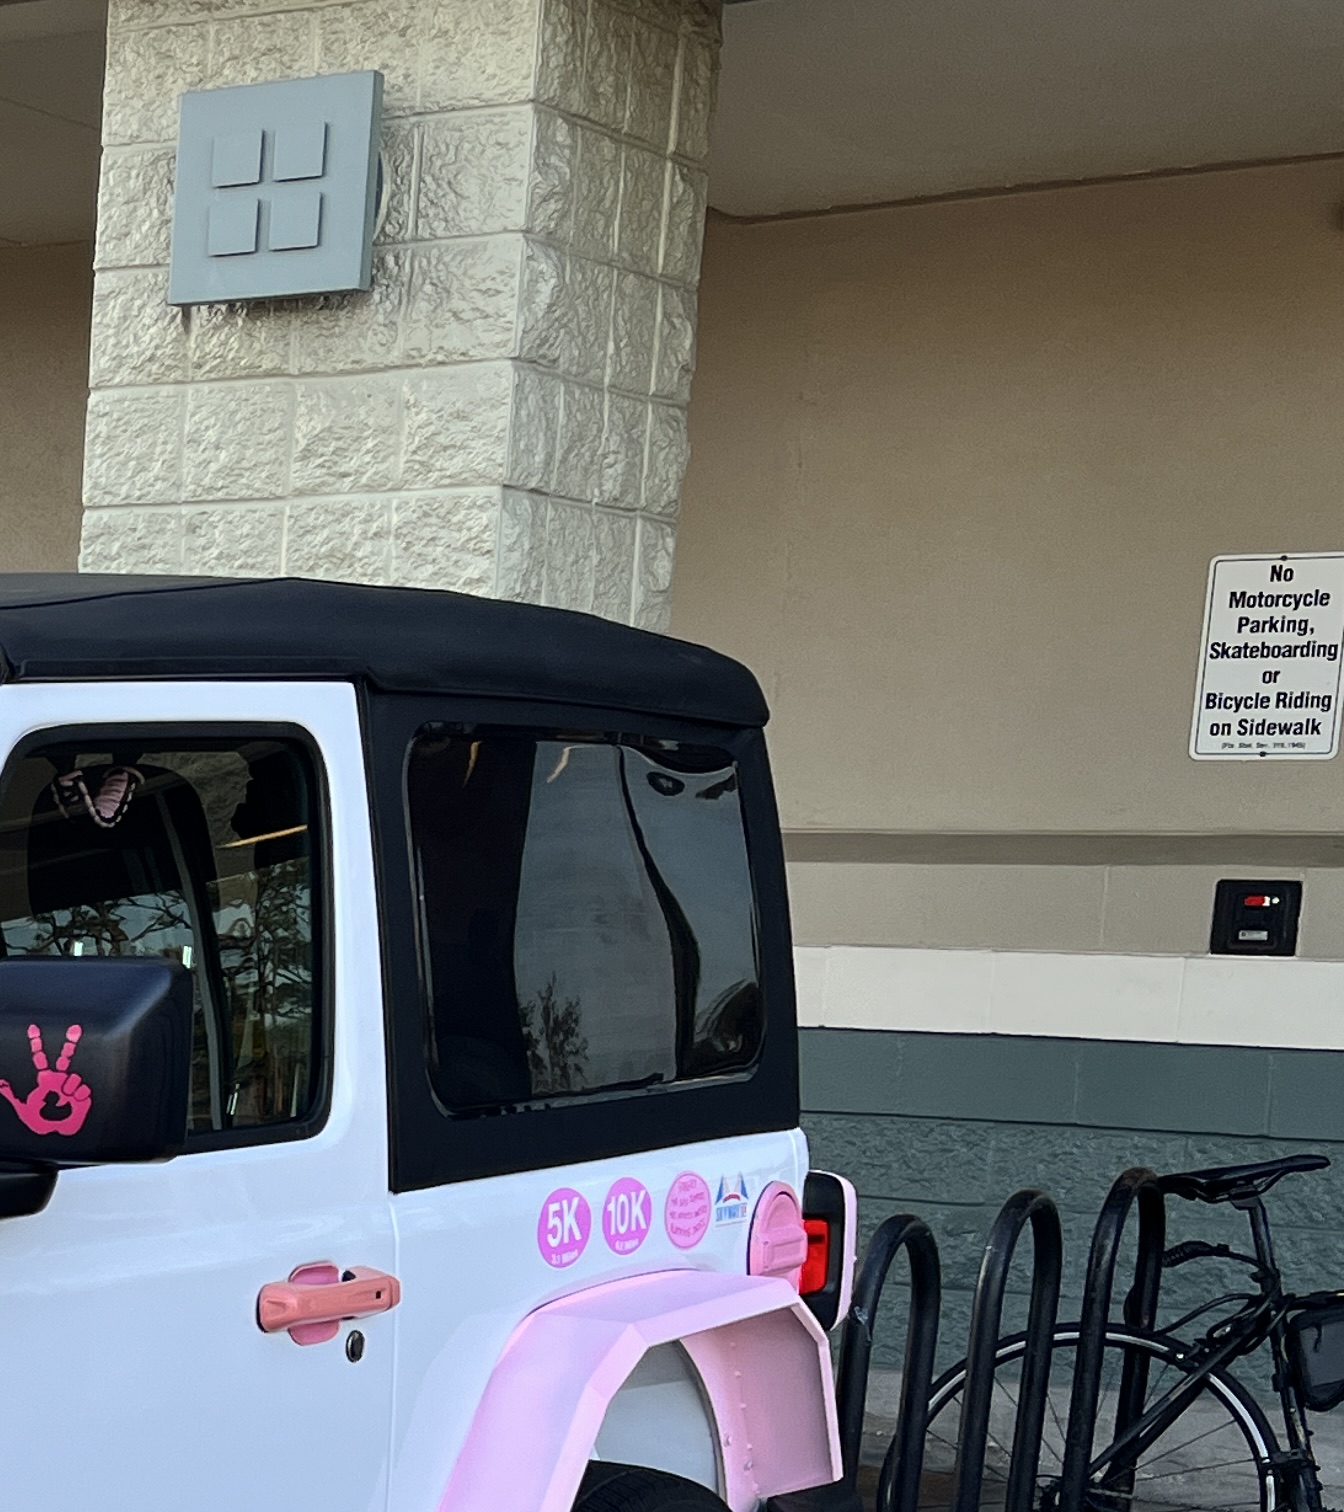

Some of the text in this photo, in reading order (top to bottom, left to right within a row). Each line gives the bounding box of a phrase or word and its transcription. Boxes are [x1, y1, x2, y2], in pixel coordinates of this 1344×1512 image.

[1270, 565, 1294, 582] No
[1229, 589, 1330, 611] Motorcycle
[1237, 615, 1315, 636] Parking,
[1209, 641, 1338, 661] Skateboarding
[1262, 669, 1281, 684] or
[1205, 691, 1332, 713] Bicycle Riding
[1209, 718, 1322, 736] on Sidewalk
[546, 1196, 582, 1247] 5K
[608, 1189, 647, 1237] 10K
